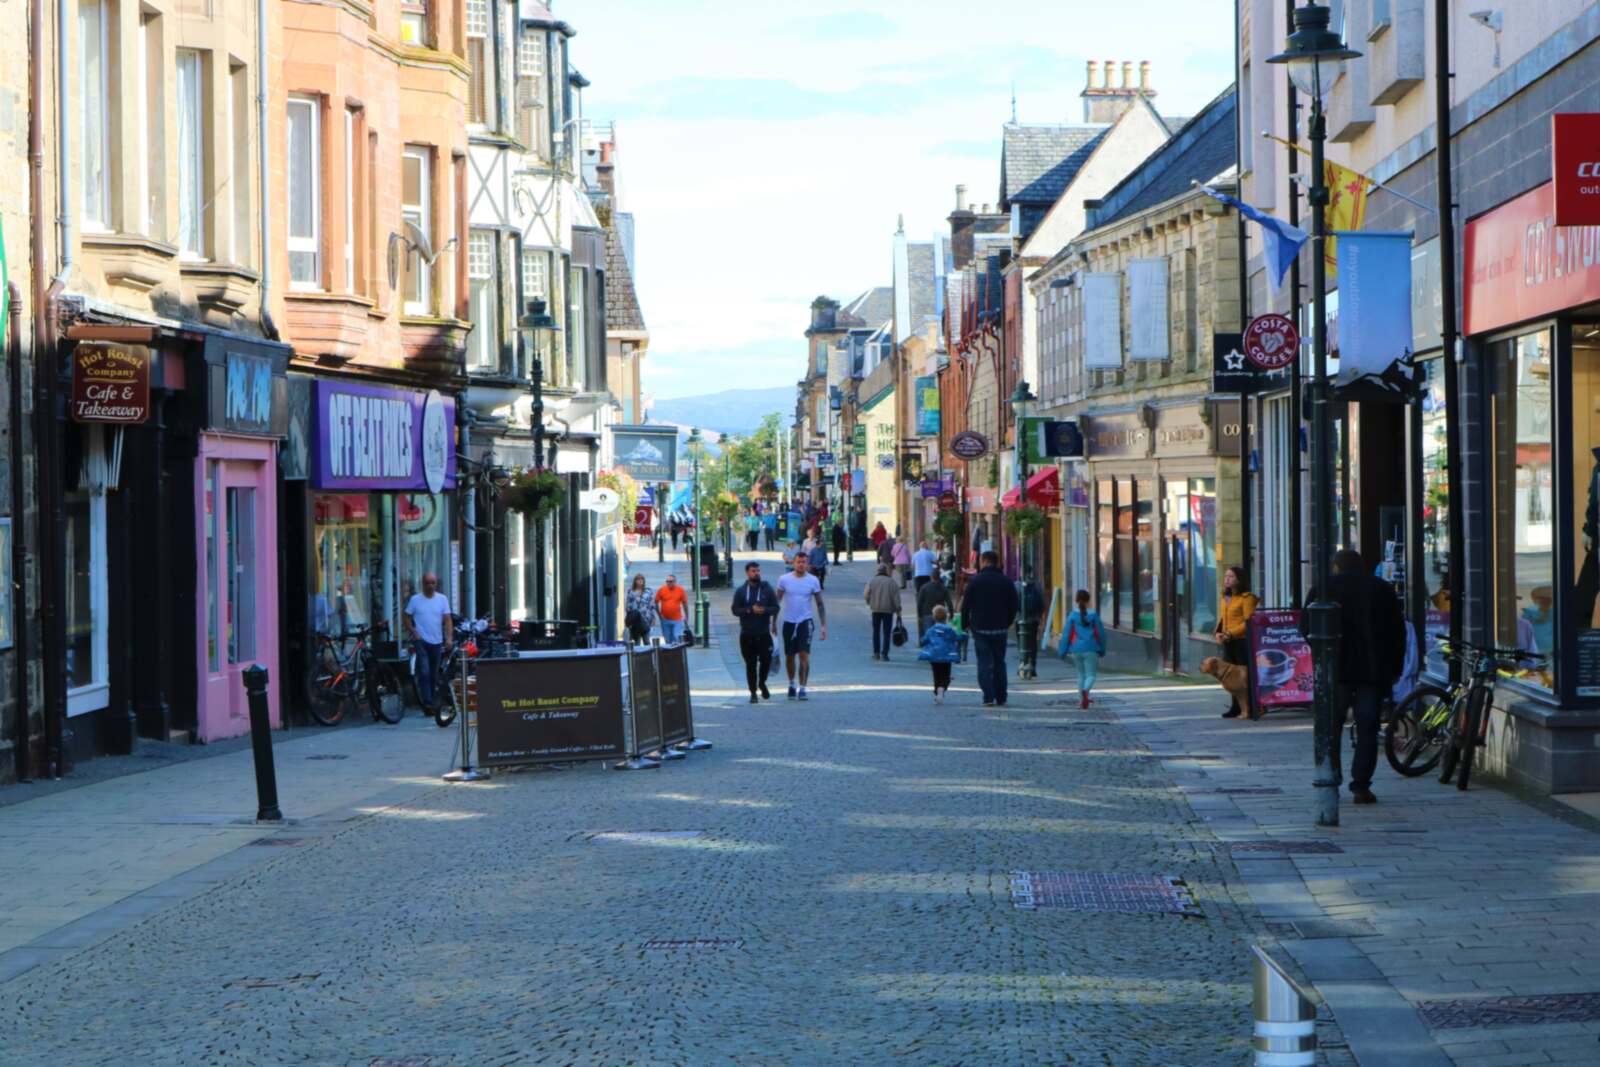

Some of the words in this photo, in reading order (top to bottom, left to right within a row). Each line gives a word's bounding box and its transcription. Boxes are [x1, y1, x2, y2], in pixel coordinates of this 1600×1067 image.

[1254, 319, 1289, 334] COSTA
[80, 351, 103, 368] Hot
[107, 348, 143, 369] Roast
[1251, 345, 1293, 364] COFFEE
[86, 367, 135, 378] Company
[86, 384, 118, 403] Cafe
[122, 386, 134, 400] &
[77, 401, 144, 420] Takeaway
[329, 393, 352, 477] OFF
[352, 396, 383, 477] BEAT
[1269, 615, 1294, 623] COSTA
[502, 699, 517, 708] The
[519, 698, 535, 707] Hot
[561, 695, 600, 705] Company
